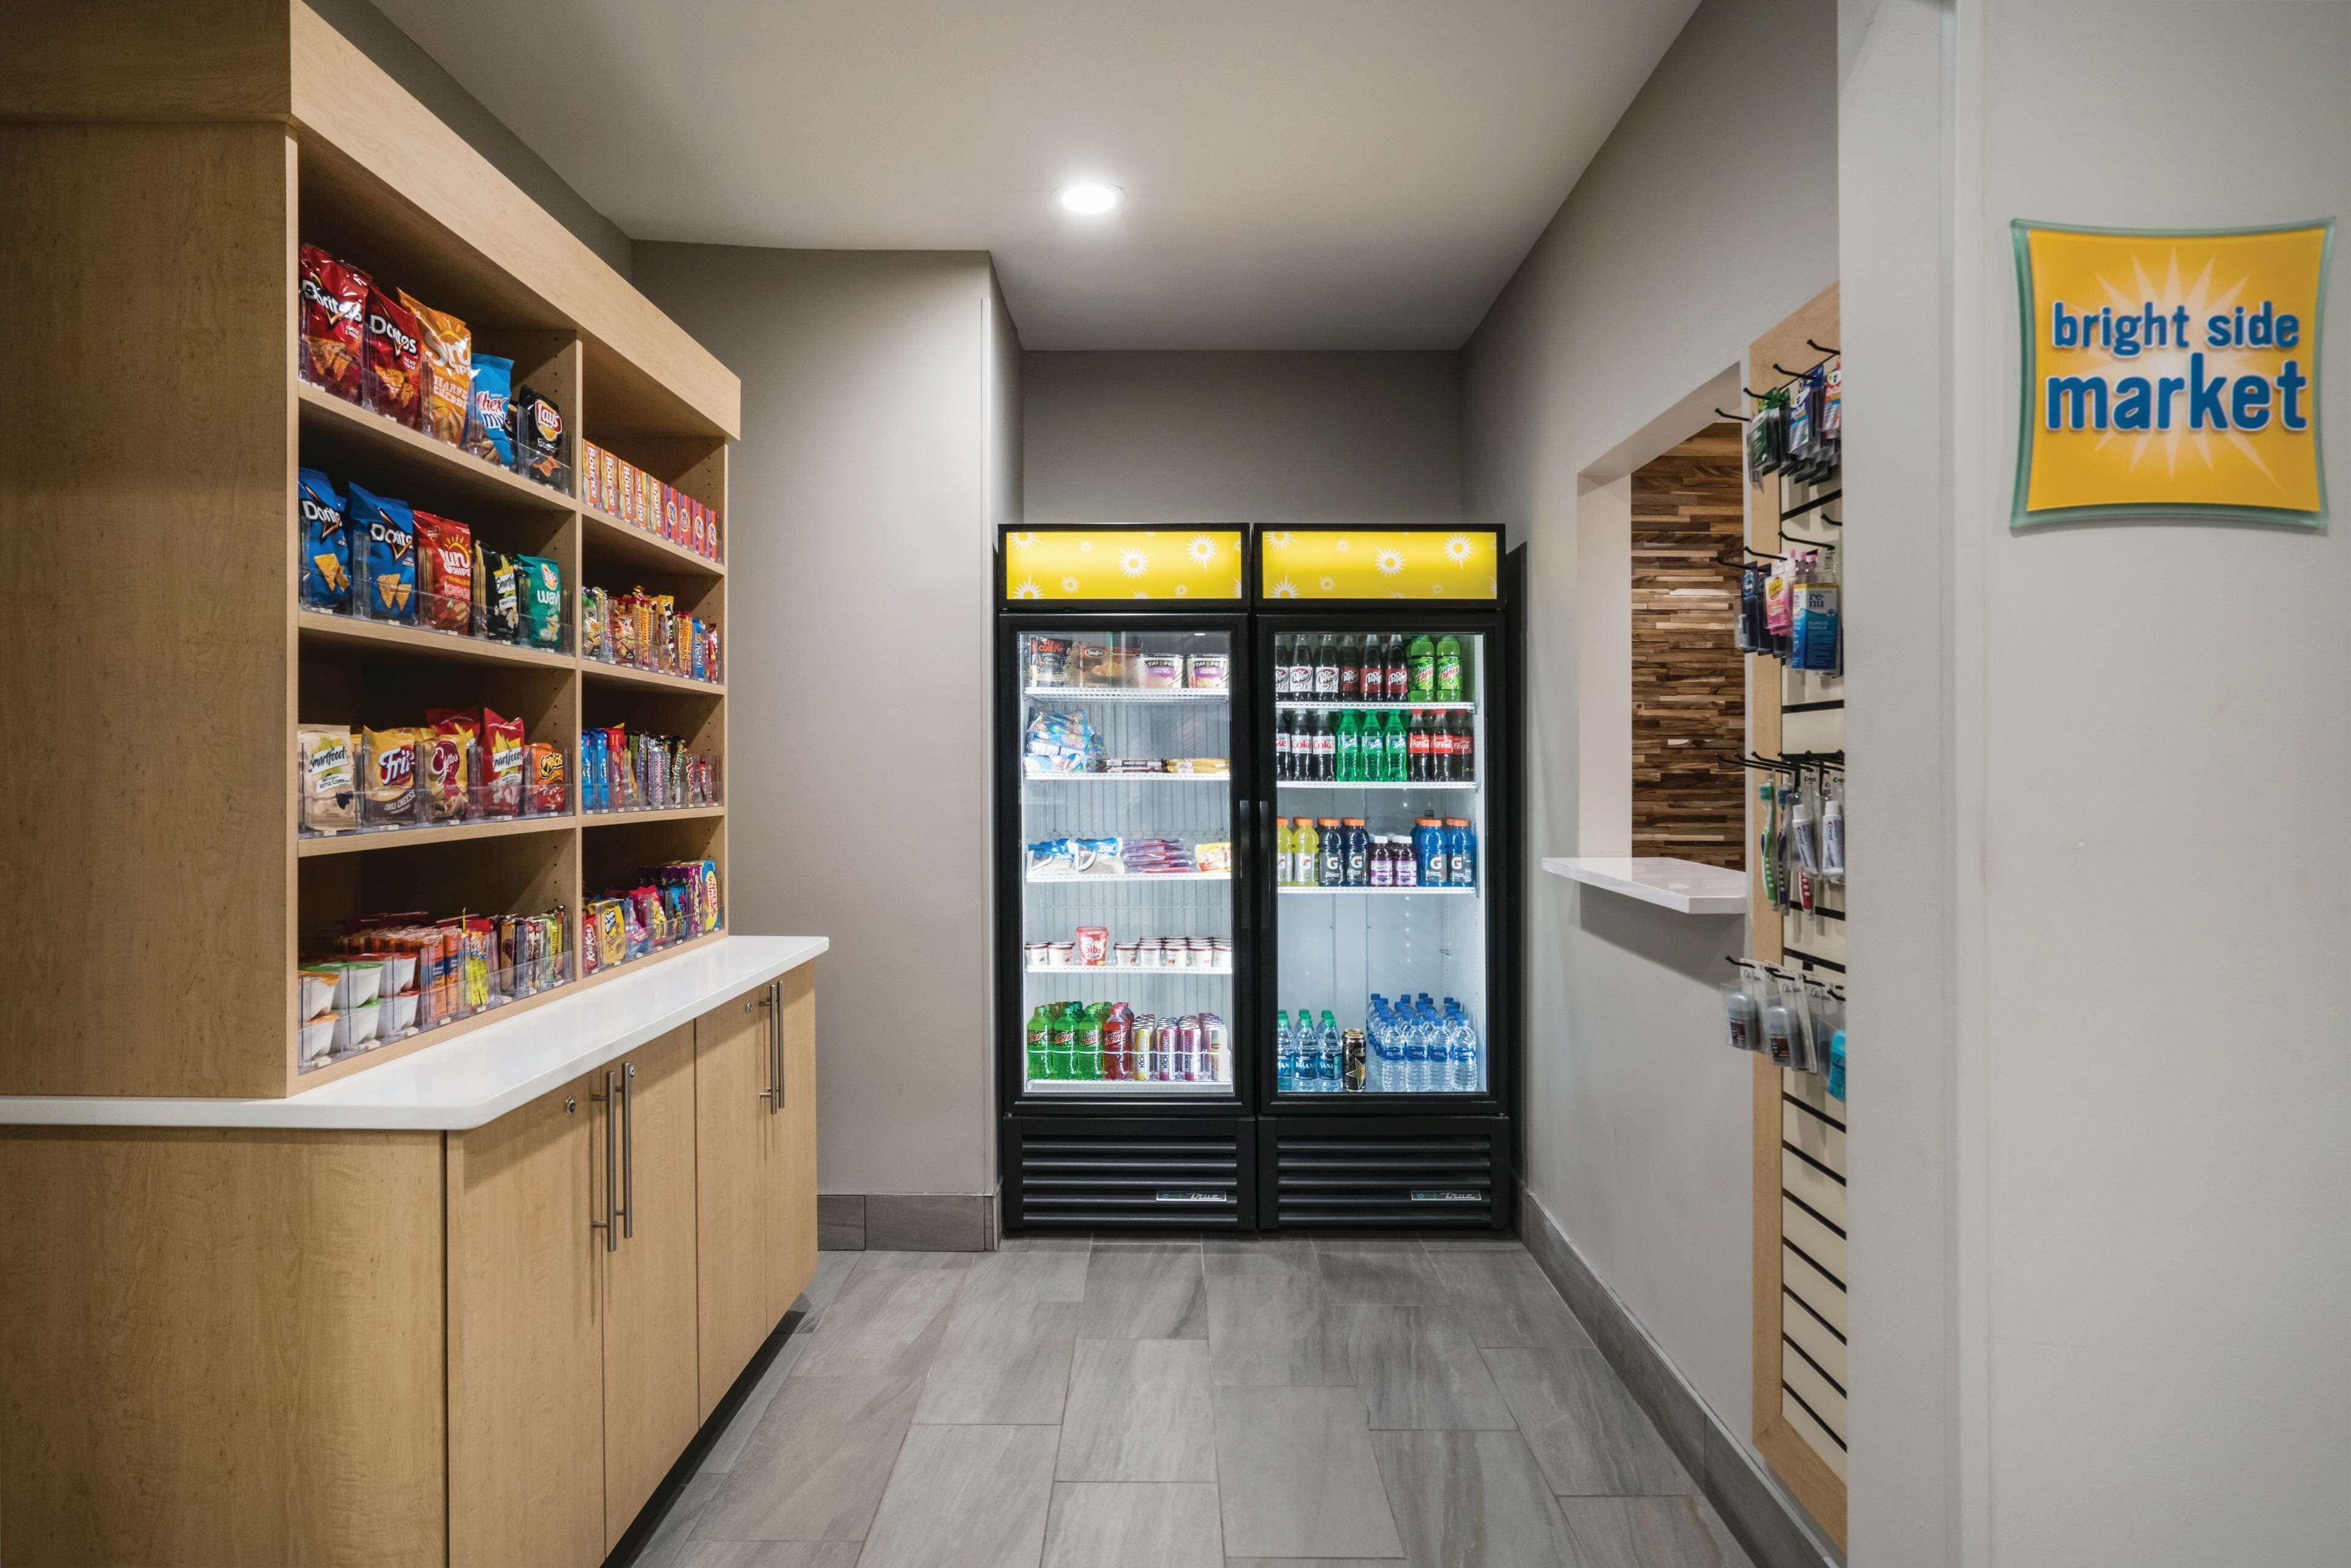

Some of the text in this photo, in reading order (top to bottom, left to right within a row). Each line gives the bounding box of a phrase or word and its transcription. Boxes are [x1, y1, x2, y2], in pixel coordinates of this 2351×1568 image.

[370, 314, 418, 354] Doritos
[2052, 301, 2300, 358] bright side
[477, 392, 506, 412] Chex
[2046, 353, 2307, 431] market
[536, 401, 560, 430] Lay's
[588, 445, 598, 500] Bounce
[606, 456, 615, 508] Bounce
[623, 464, 632, 516] Bounce
[370, 523, 413, 549] Dorito
[438, 548, 470, 573] Sun
[397, 789, 416, 808] CHEESE
[1327, 857, 1338, 869] G
[1350, 855, 1362, 869] G
[1430, 857, 1442, 869] G
[1451, 857, 1462, 869] G
[1137, 1036, 1146, 1068] KICKTART
